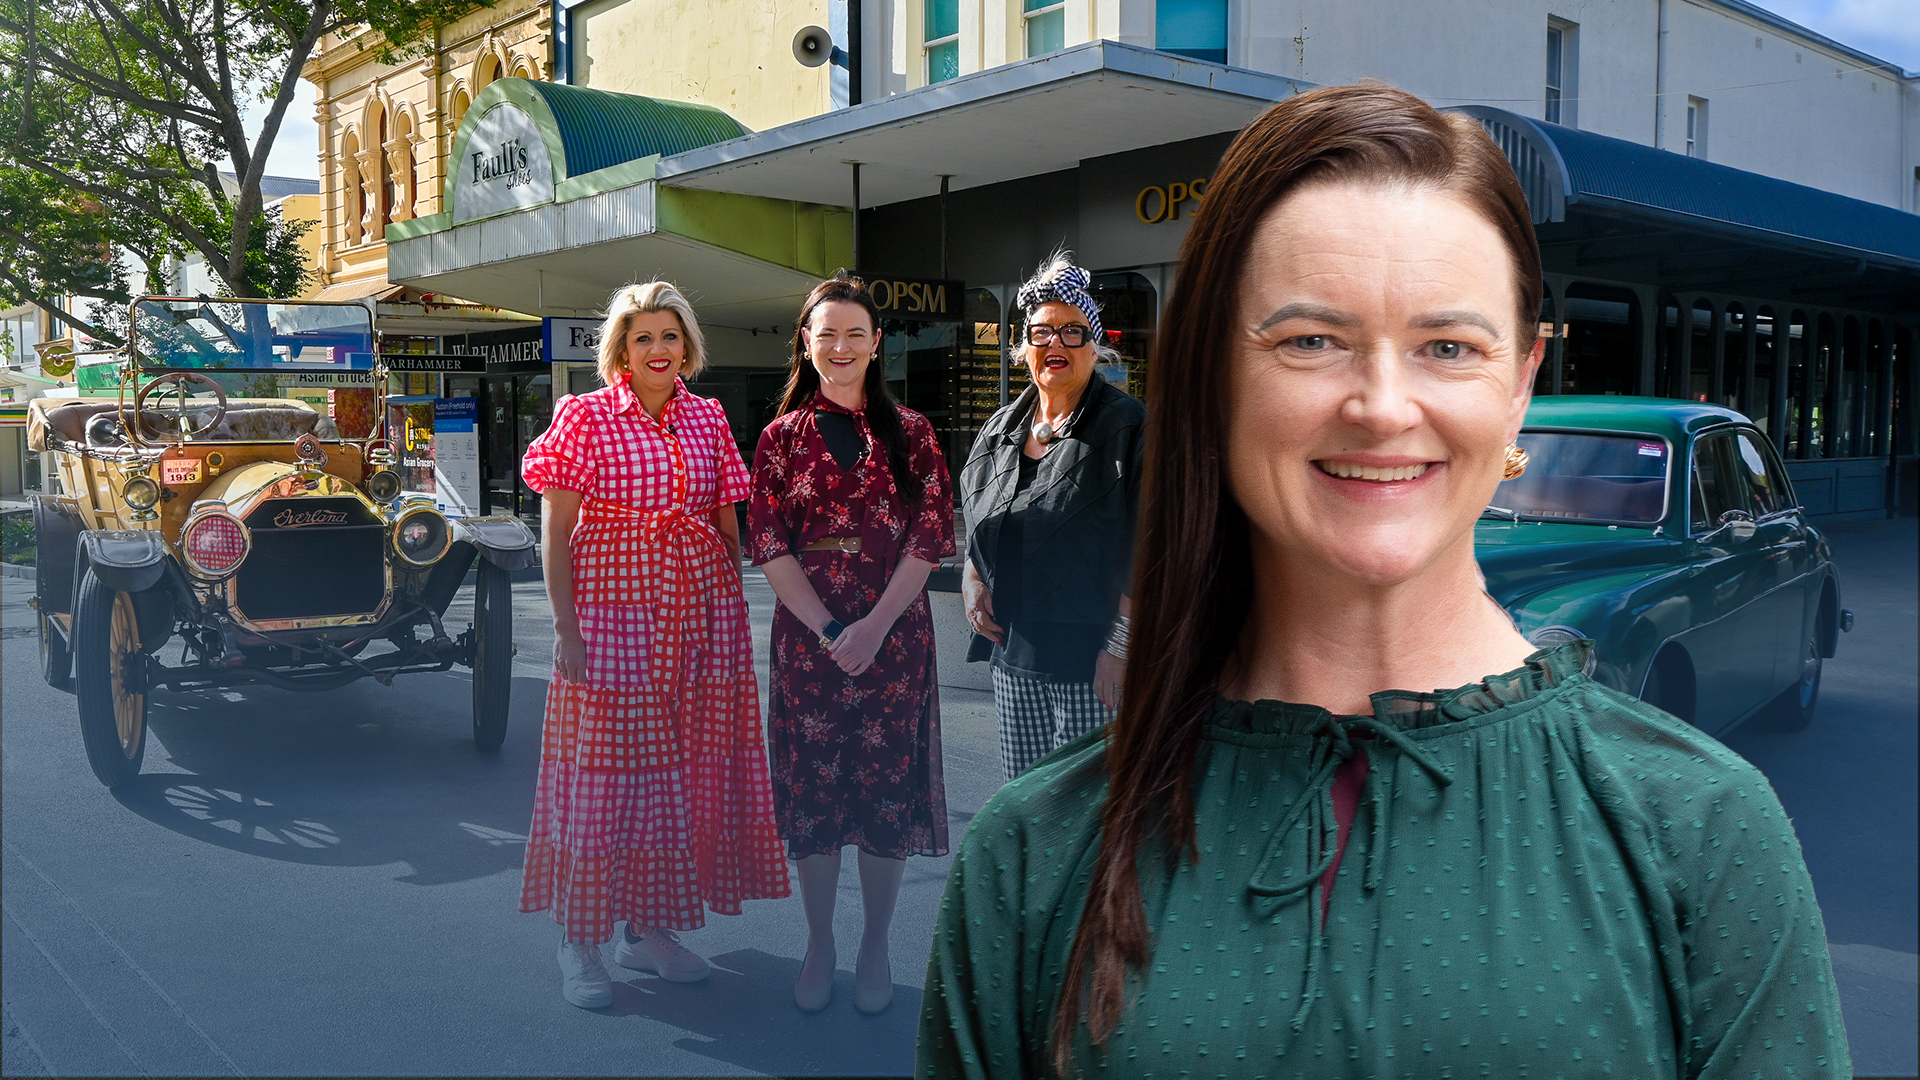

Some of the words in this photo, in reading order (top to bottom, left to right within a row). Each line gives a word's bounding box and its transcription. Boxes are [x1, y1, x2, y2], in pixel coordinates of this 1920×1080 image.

[471, 138, 528, 184] Faull's
[506, 162, 533, 190] shoes
[868, 280, 947, 313] OPSM
[569, 327, 600, 348] Fa
[452, 341, 541, 363] WRHAMMER
[381, 358, 462, 370] WARHAMMER
[403, 457, 416, 467] Asian
[416, 457, 435, 470] Grocery
[170, 473, 196, 481] 1913
[273, 508, 349, 528] Overland
